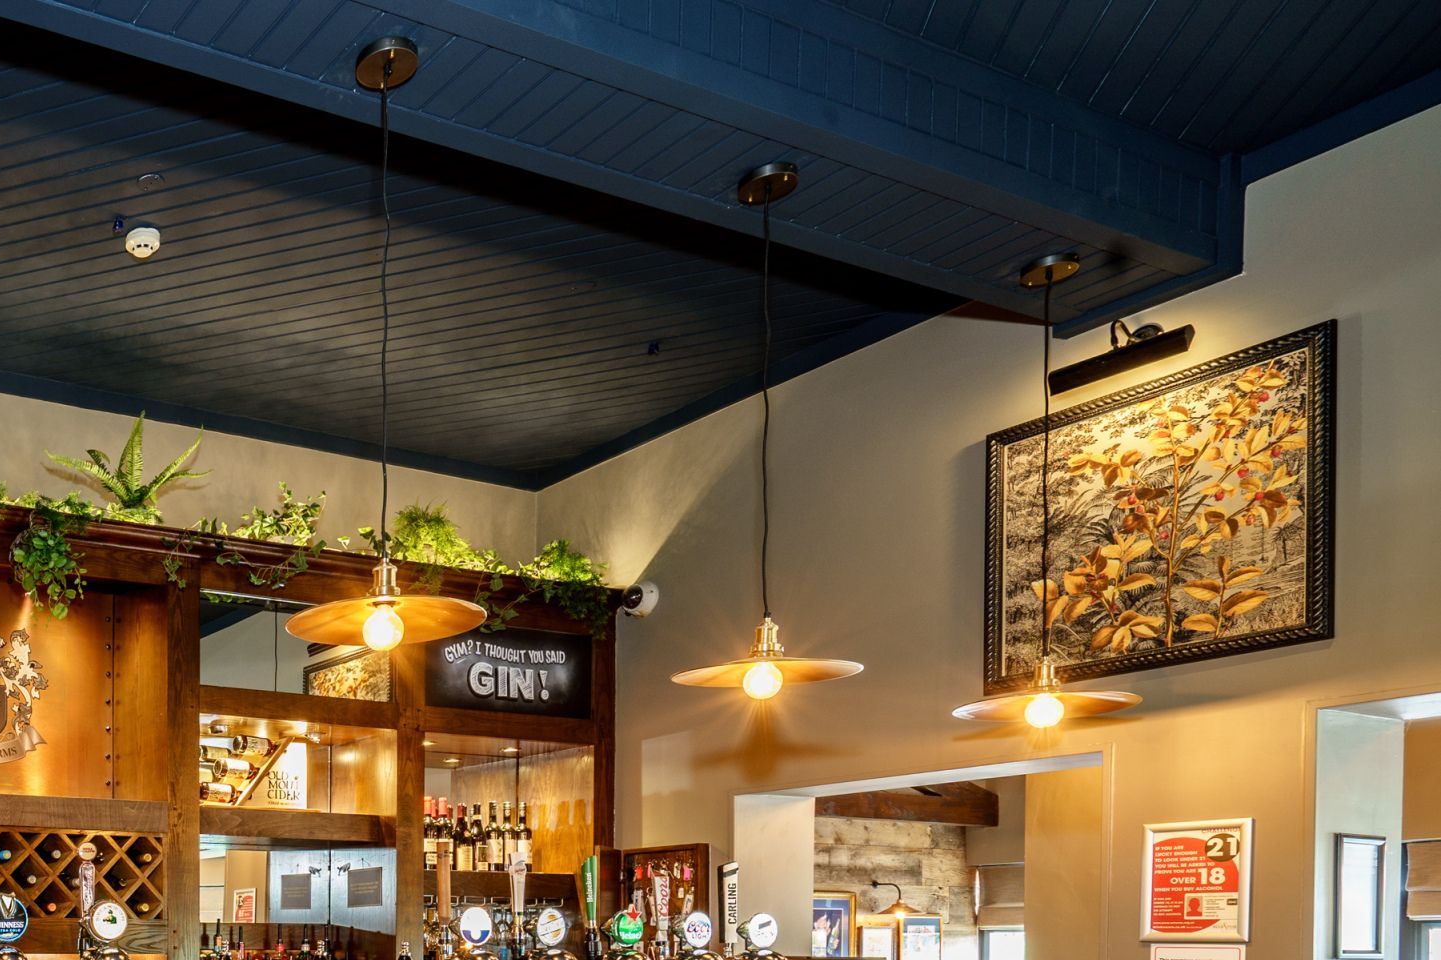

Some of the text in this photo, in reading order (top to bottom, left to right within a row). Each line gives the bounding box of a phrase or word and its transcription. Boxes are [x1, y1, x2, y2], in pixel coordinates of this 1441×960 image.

[444, 639, 566, 665] GYM? I THOUGHT YOU SAID
[469, 662, 549, 700] GIN!
[268, 771, 288, 780] OLD
[1207, 837, 1237, 857] 21
[1198, 867, 1226, 885] 18
[728, 883, 737, 925] CARLING
